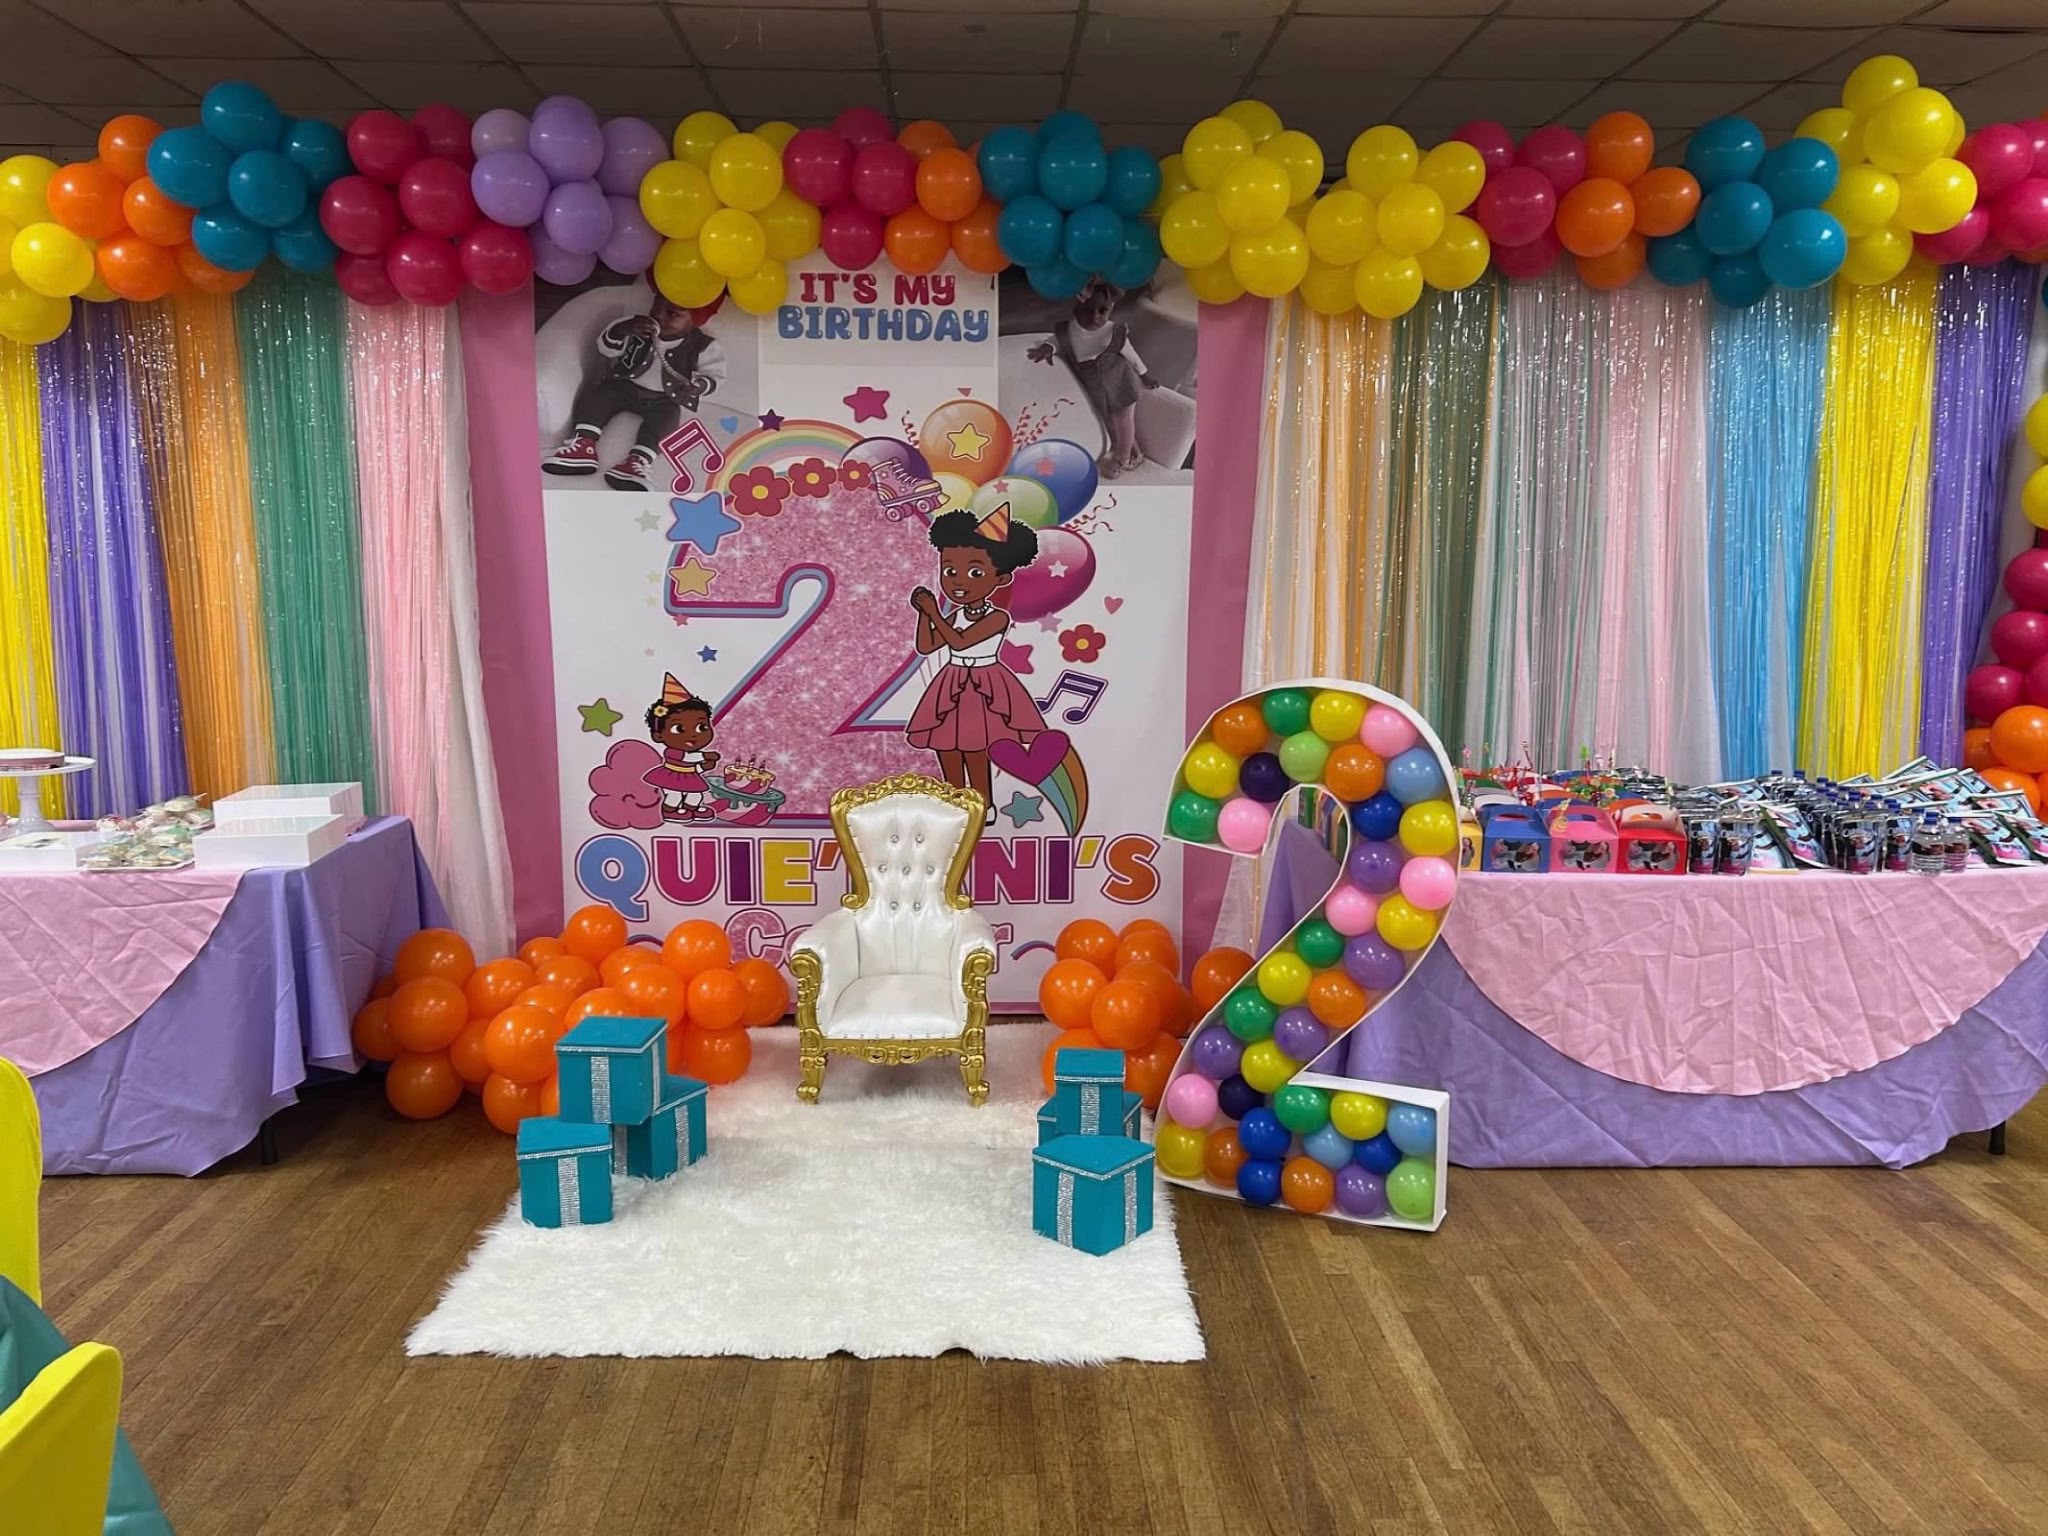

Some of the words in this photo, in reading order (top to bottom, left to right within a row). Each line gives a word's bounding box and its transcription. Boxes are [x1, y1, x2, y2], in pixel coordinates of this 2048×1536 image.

[800, 272, 878, 304] IT'S
[893, 274, 956, 306] MY
[778, 305, 989, 342] BIRTHDAY
[575, 833, 1161, 922] QUIE'NI'S
[1154, 677, 1460, 1232] 2
